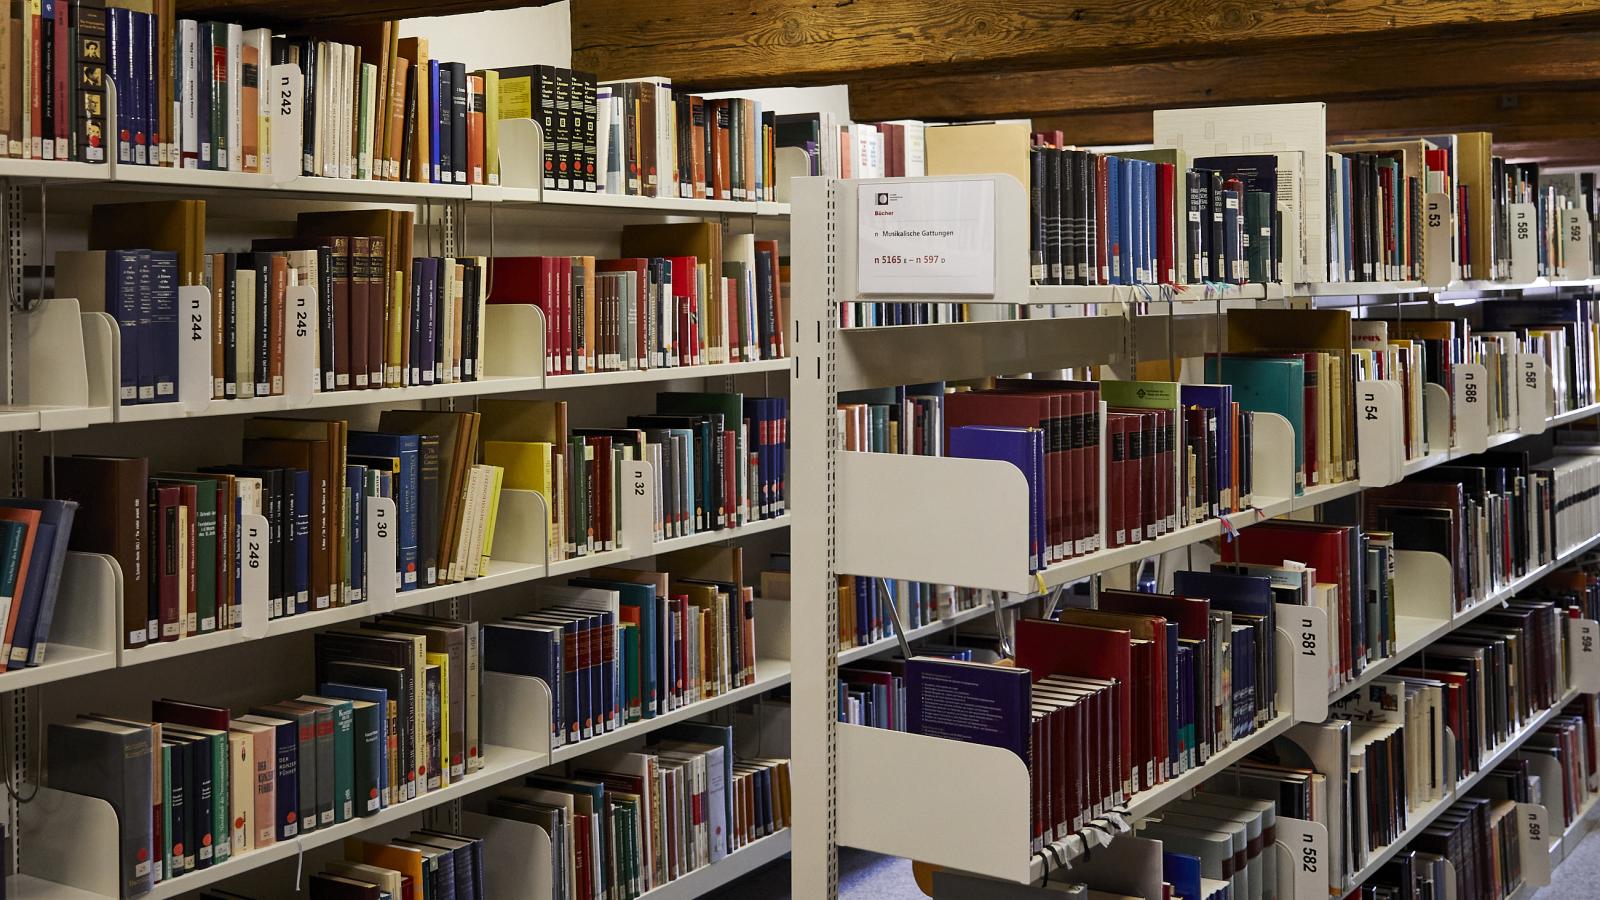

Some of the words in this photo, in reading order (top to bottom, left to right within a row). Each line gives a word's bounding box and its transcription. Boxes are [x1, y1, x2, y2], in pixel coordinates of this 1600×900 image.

[282, 77, 289, 85] n
[281, 91, 291, 115] 242
[1429, 214, 1440, 227] 53
[921, 230, 954, 238] Gattungen
[1518, 222, 1528, 239] 585
[1571, 226, 1580, 241] 592
[874, 256, 880, 264] n
[882, 255, 902, 264] 5165
[916, 256, 921, 264] n
[923, 255, 939, 264] 597
[192, 300, 199, 308] n
[192, 314, 201, 341] 244
[297, 312, 307, 337] 245
[1526, 372, 1536, 388] 587
[1465, 384, 1476, 402] 586
[1365, 406, 1377, 420] 54
[635, 482, 644, 495] 32
[377, 509, 384, 517] n
[250, 529, 257, 537] n
[377, 522, 387, 537] 30
[249, 542, 259, 568] 249
[1302, 619, 1312, 627] n
[1302, 633, 1315, 656] 581
[1582, 636, 1592, 652] 594
[278, 761, 297, 770] KONZER
[1303, 834, 1313, 842] n
[1529, 823, 1540, 840] 591
[1303, 848, 1316, 872] 582
